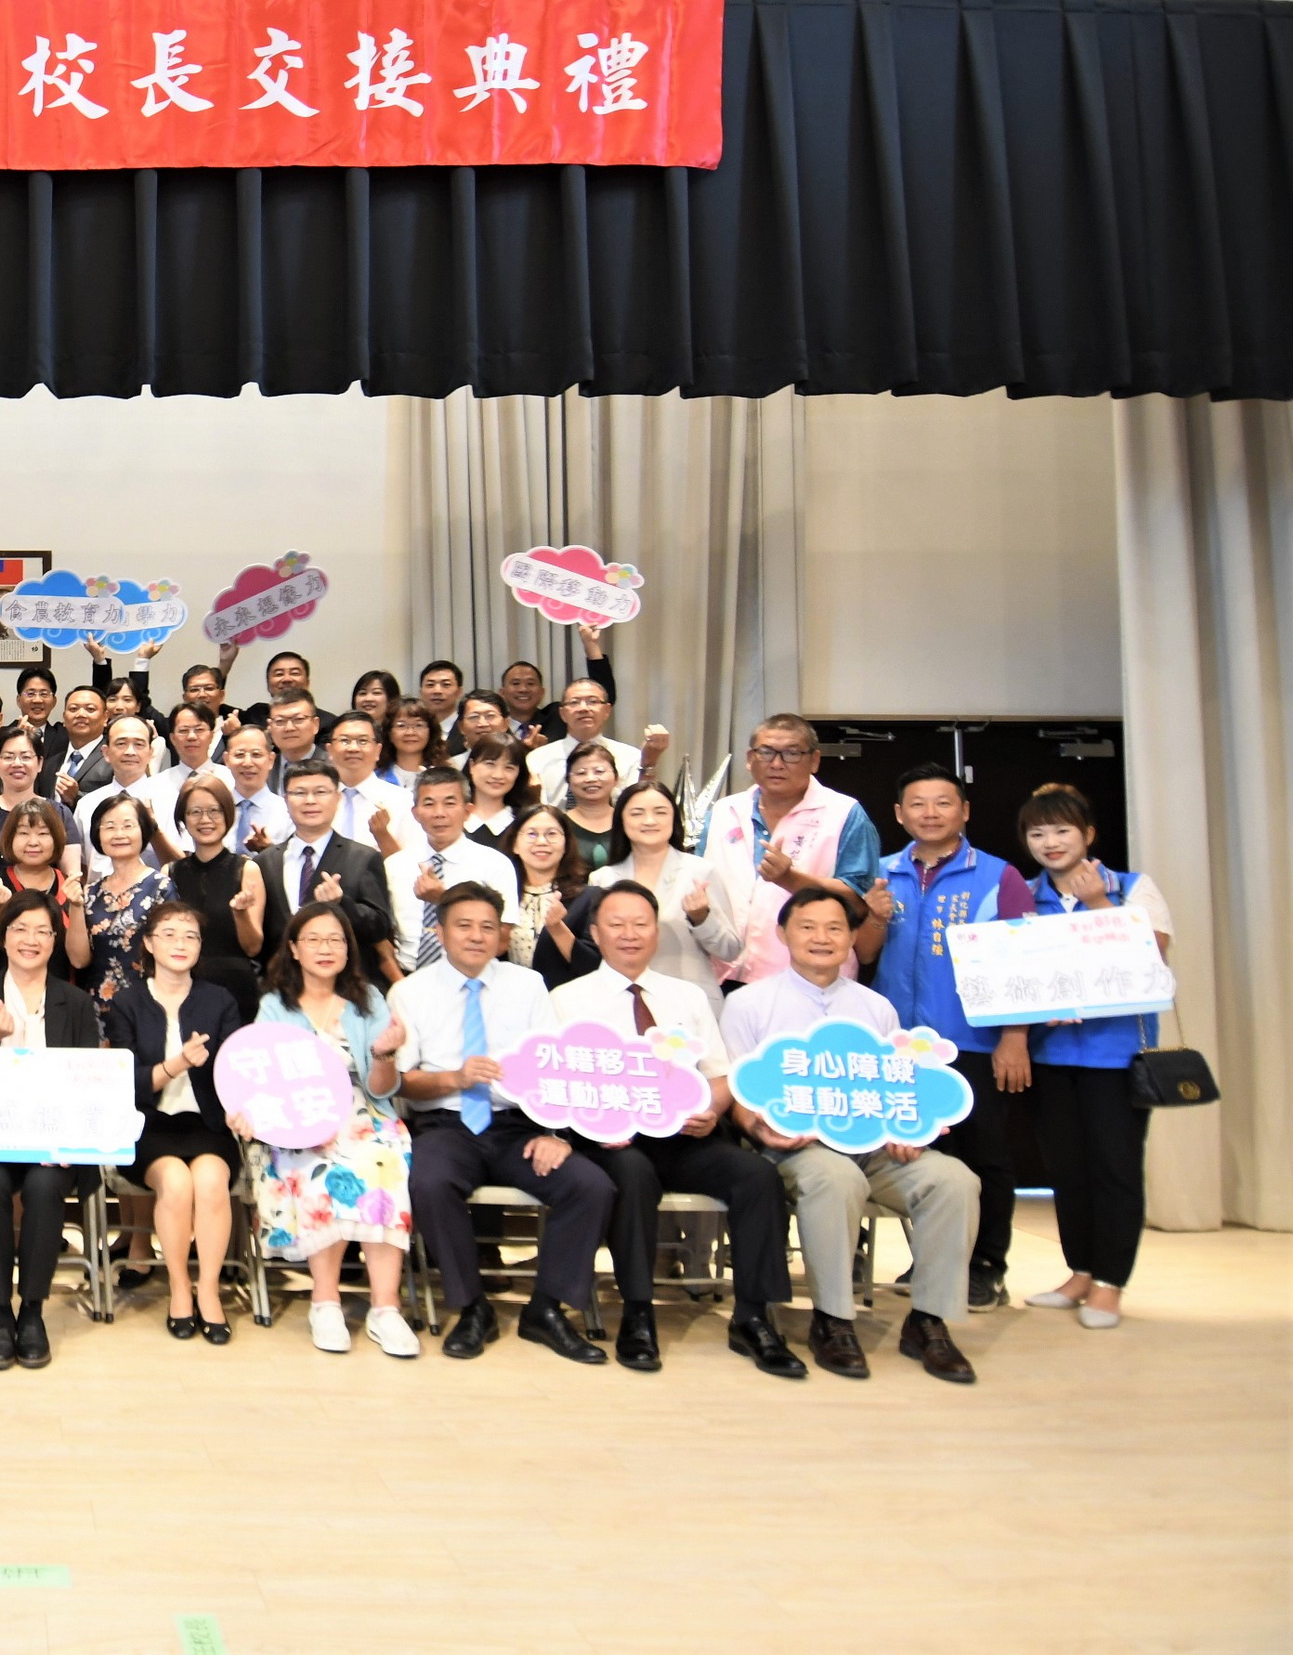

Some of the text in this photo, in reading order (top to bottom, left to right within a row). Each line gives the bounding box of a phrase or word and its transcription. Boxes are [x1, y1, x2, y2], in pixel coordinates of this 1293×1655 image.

[5, 599, 123, 624] 食農教育力
[123, 603, 178, 628] 學力
[214, 574, 323, 638] 未來想像力
[960, 962, 1174, 1008] 藝術創作力
[535, 1042, 659, 1078] 外籍移工
[780, 1046, 917, 1085] 身心障礙
[539, 1076, 663, 1116] 運動樂活
[782, 1083, 920, 1123] 運動樂活
